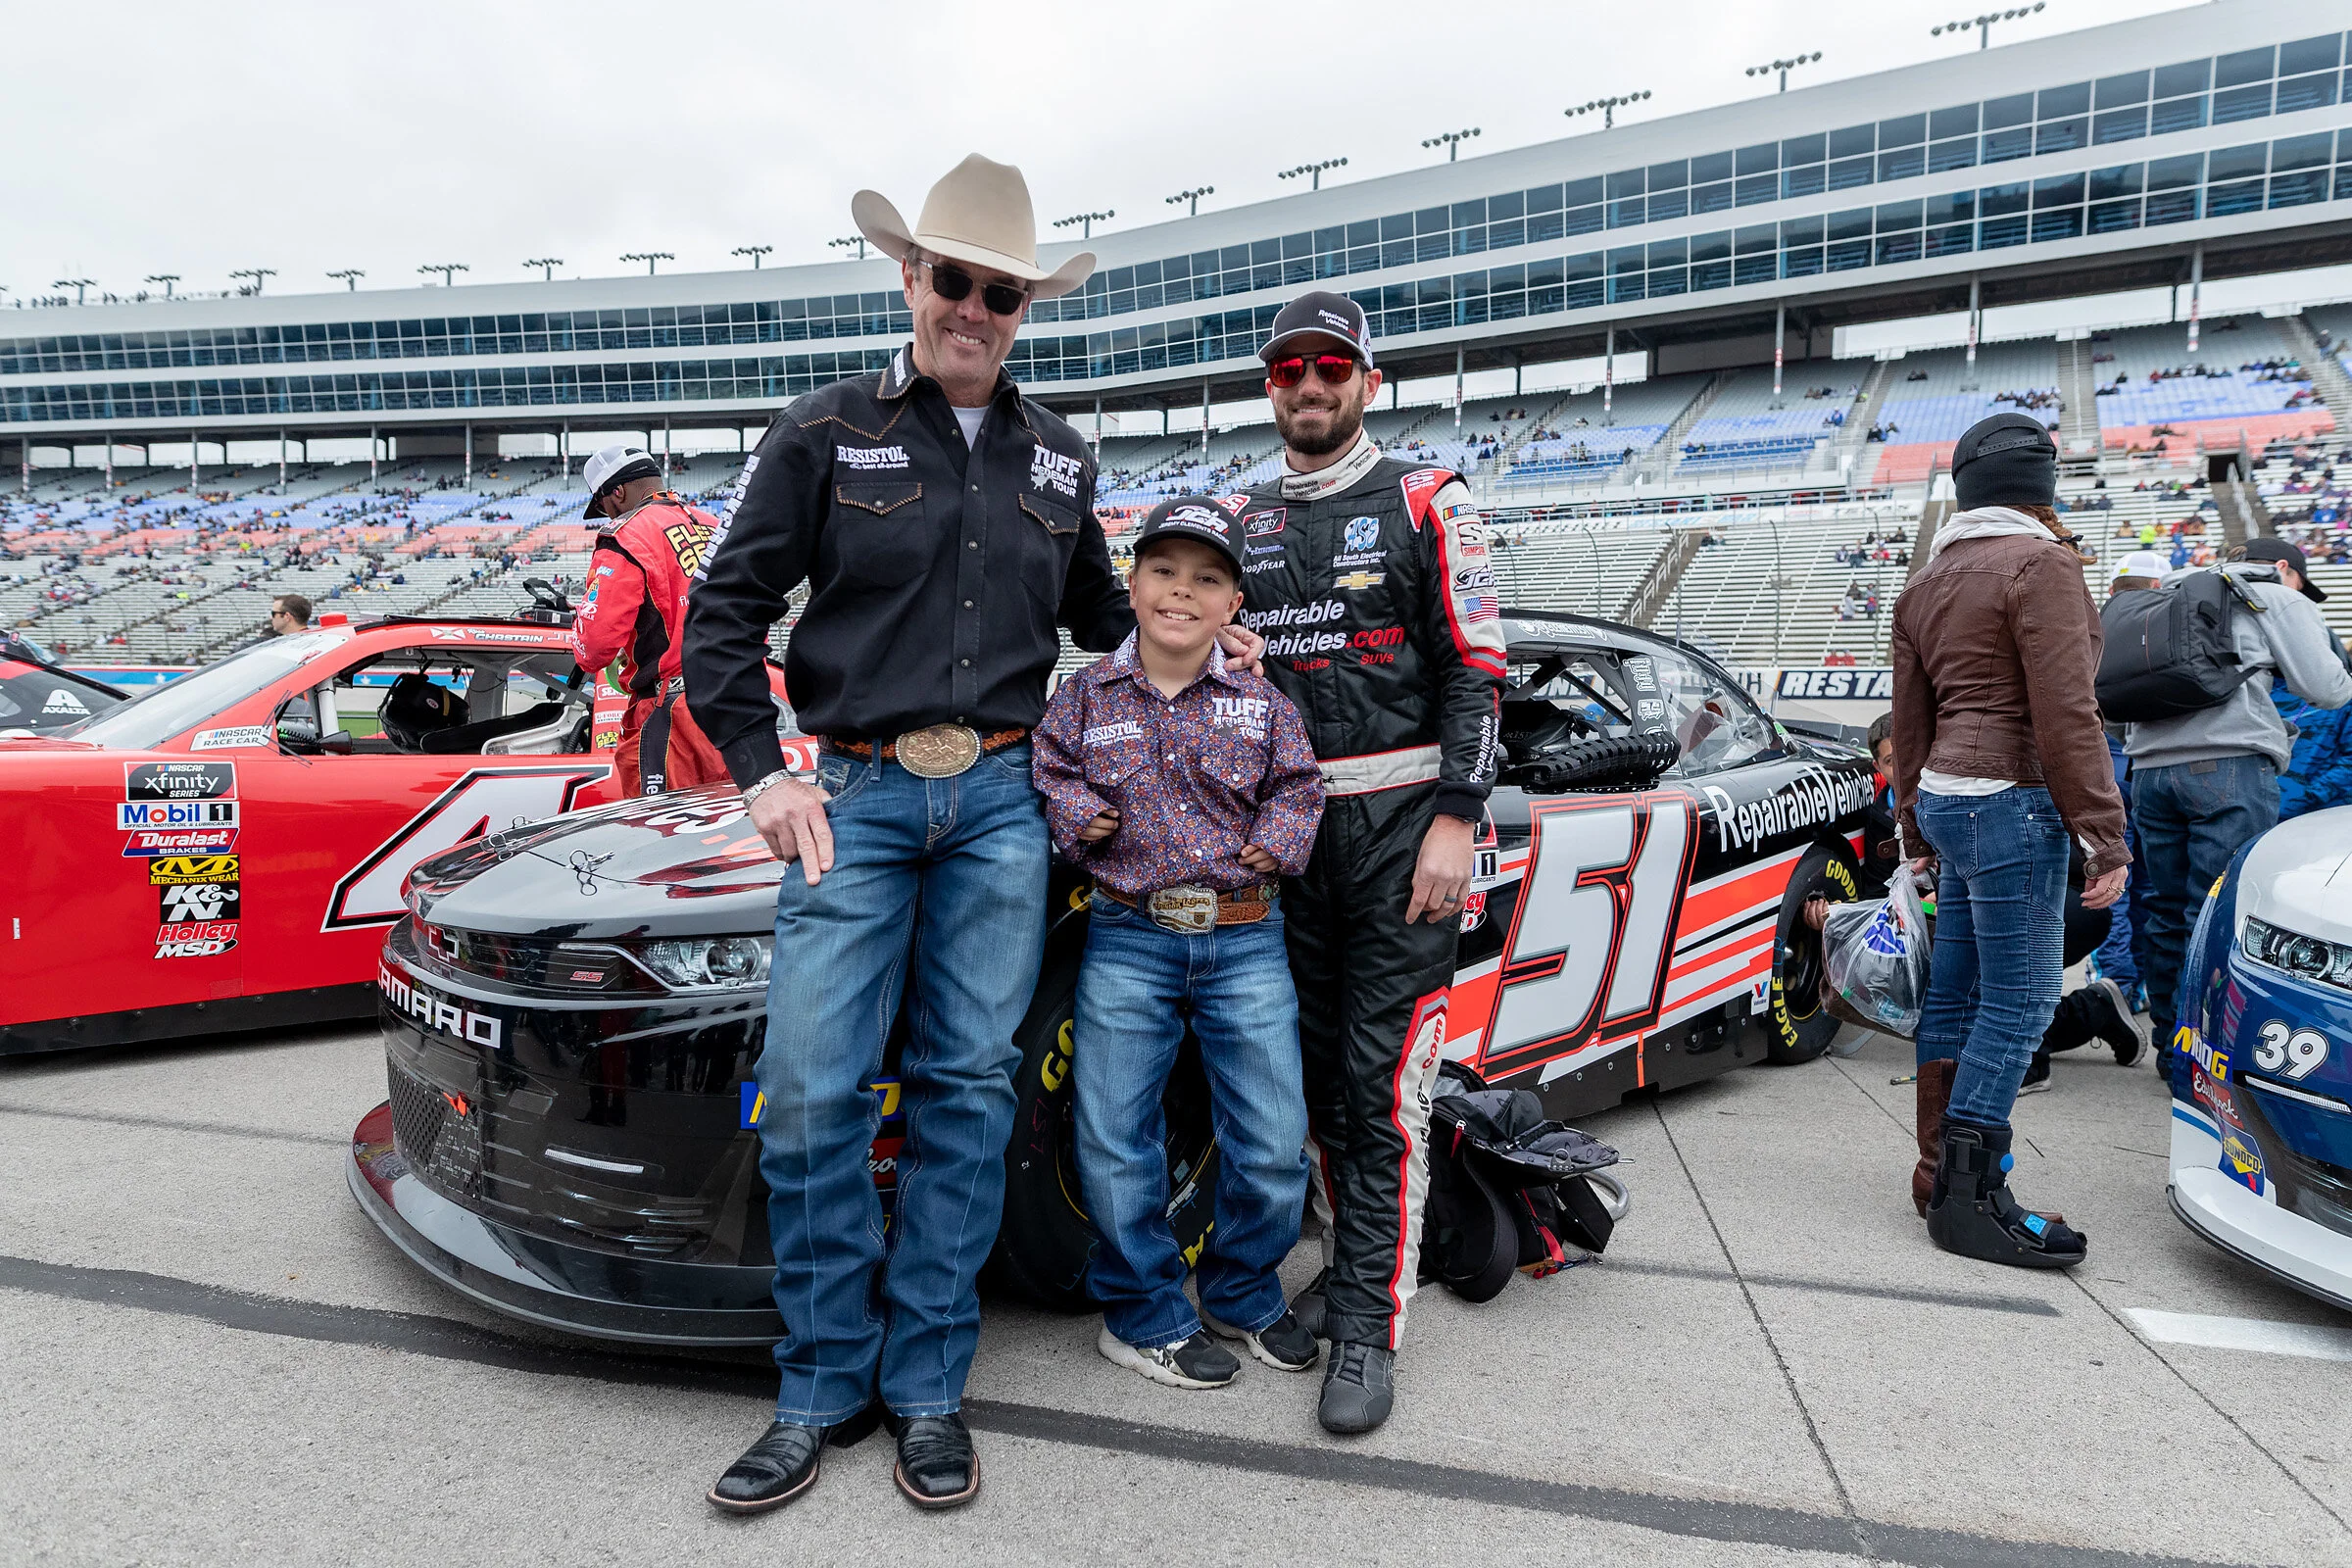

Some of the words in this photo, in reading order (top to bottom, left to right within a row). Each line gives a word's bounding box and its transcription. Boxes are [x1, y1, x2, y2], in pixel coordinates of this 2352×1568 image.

[837, 445, 909, 464] RESISTOL
[1034, 444, 1082, 477] TUFF
[1031, 463, 1077, 488] HEDEMAN
[1053, 479, 1076, 498] TOUR
[1180, 520, 1211, 535] CLEMENTS
[1249, 517, 1279, 532] xfinity
[1343, 553, 1359, 562] South
[1360, 550, 1388, 560] Electrical
[1239, 600, 1345, 633] Repairable
[1293, 658, 1330, 671] Trucks
[1360, 653, 1396, 665] SUVs
[42, 706, 91, 715] AXALTA
[1212, 697, 1269, 718] TUFF
[204, 737, 232, 747] RACE
[236, 736, 259, 745] CAR
[219, 728, 262, 738] NASCAR
[1082, 720, 1143, 745] RESISTOL
[1239, 726, 1265, 741] TOUR
[144, 772, 219, 794] xfinity
[170, 789, 200, 798] SERIES
[124, 804, 200, 823] Mobil
[215, 804, 224, 821] 1
[138, 831, 228, 848] Duralast
[150, 874, 207, 885] MECHANIX
[208, 871, 239, 883] WEAR
[156, 922, 238, 944] Holley
[1479, 795, 1694, 1068] 51
[154, 941, 227, 959] MSD
[569, 970, 606, 983] SS
[1772, 976, 1799, 1048] EAGLE
[2254, 1018, 2328, 1080] 39
[2225, 1140, 2262, 1172] SUNOCO
